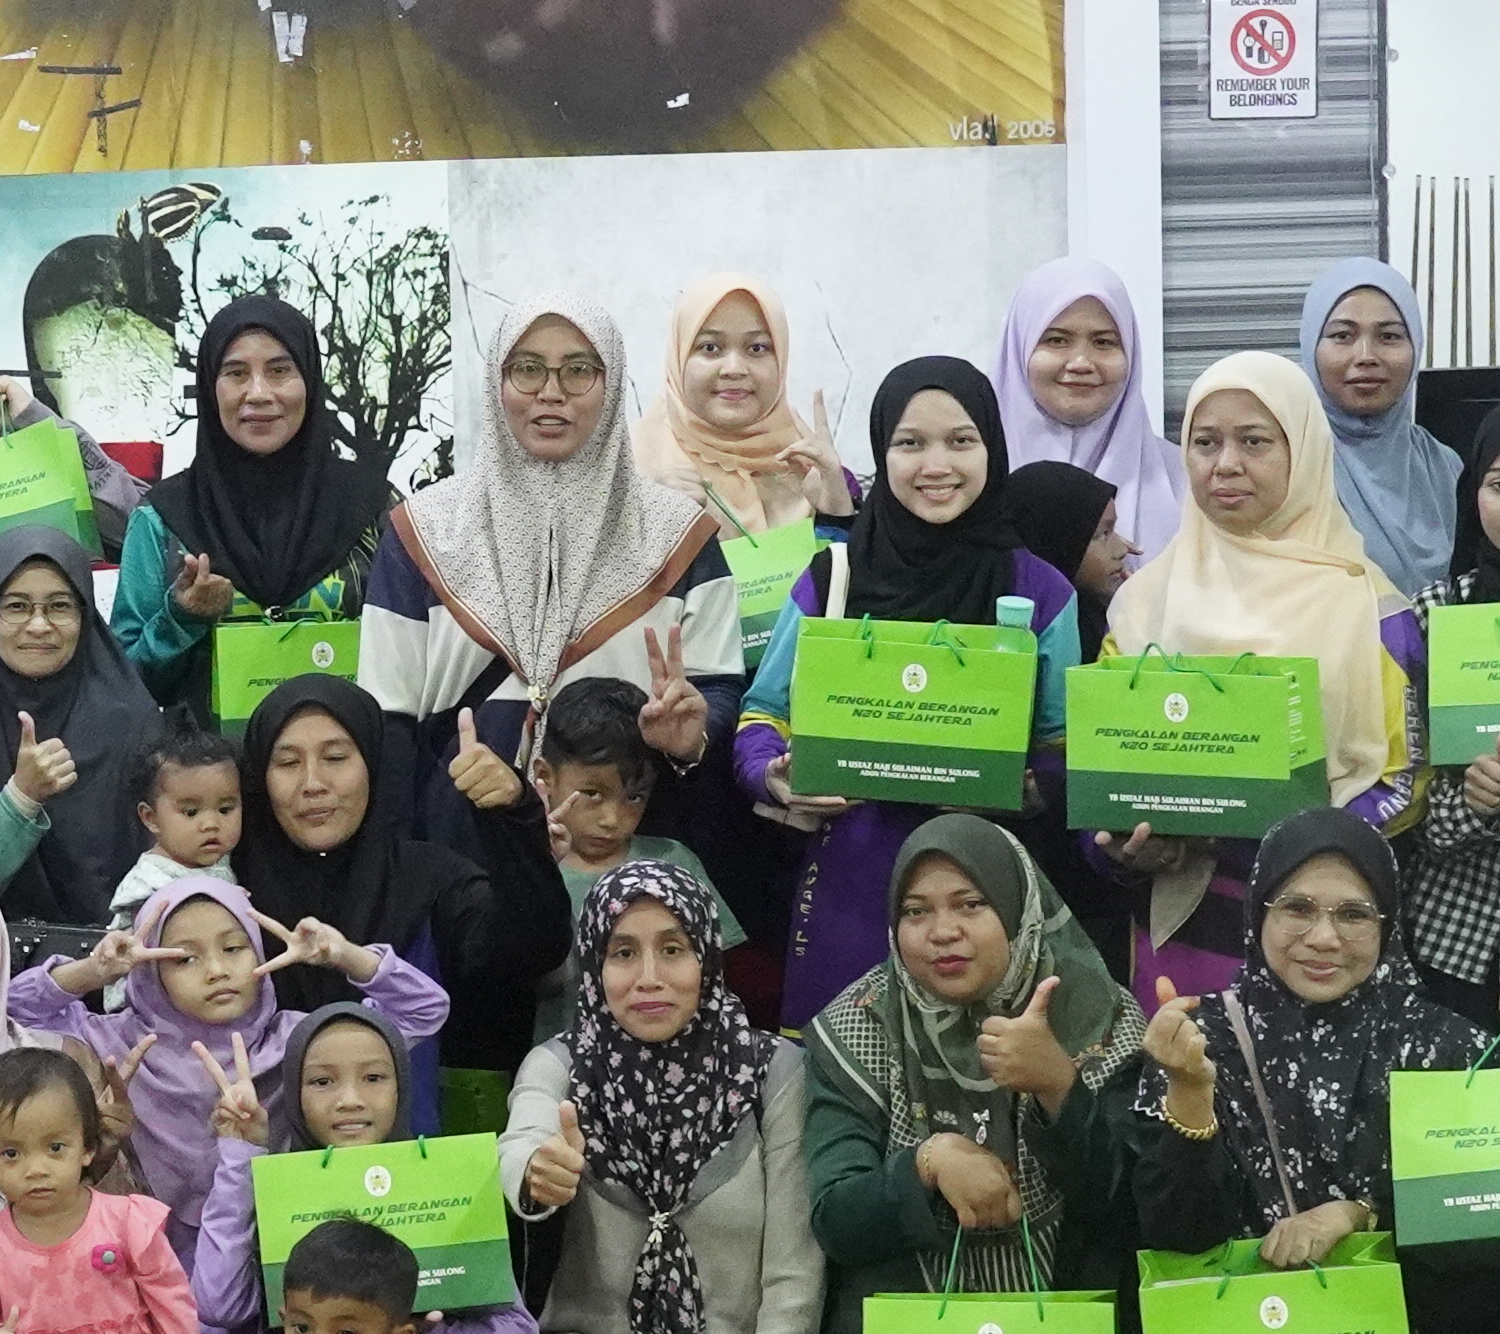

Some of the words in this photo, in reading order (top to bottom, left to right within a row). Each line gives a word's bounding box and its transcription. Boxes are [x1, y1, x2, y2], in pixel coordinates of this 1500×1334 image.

[1217, 79, 1276, 91] REMEMBER
[1280, 78, 1310, 90] YOUR
[1230, 93, 1297, 107] BELONGINGS
[825, 694, 915, 709] PENGKALAN
[917, 701, 1000, 716] BERANGAN
[885, 711, 972, 726] SEJAHTERA
[1094, 727, 1179, 740] PENGKALAN
[1180, 731, 1260, 743] BERANGAN
[1151, 741, 1235, 754] SEJAHTERA
